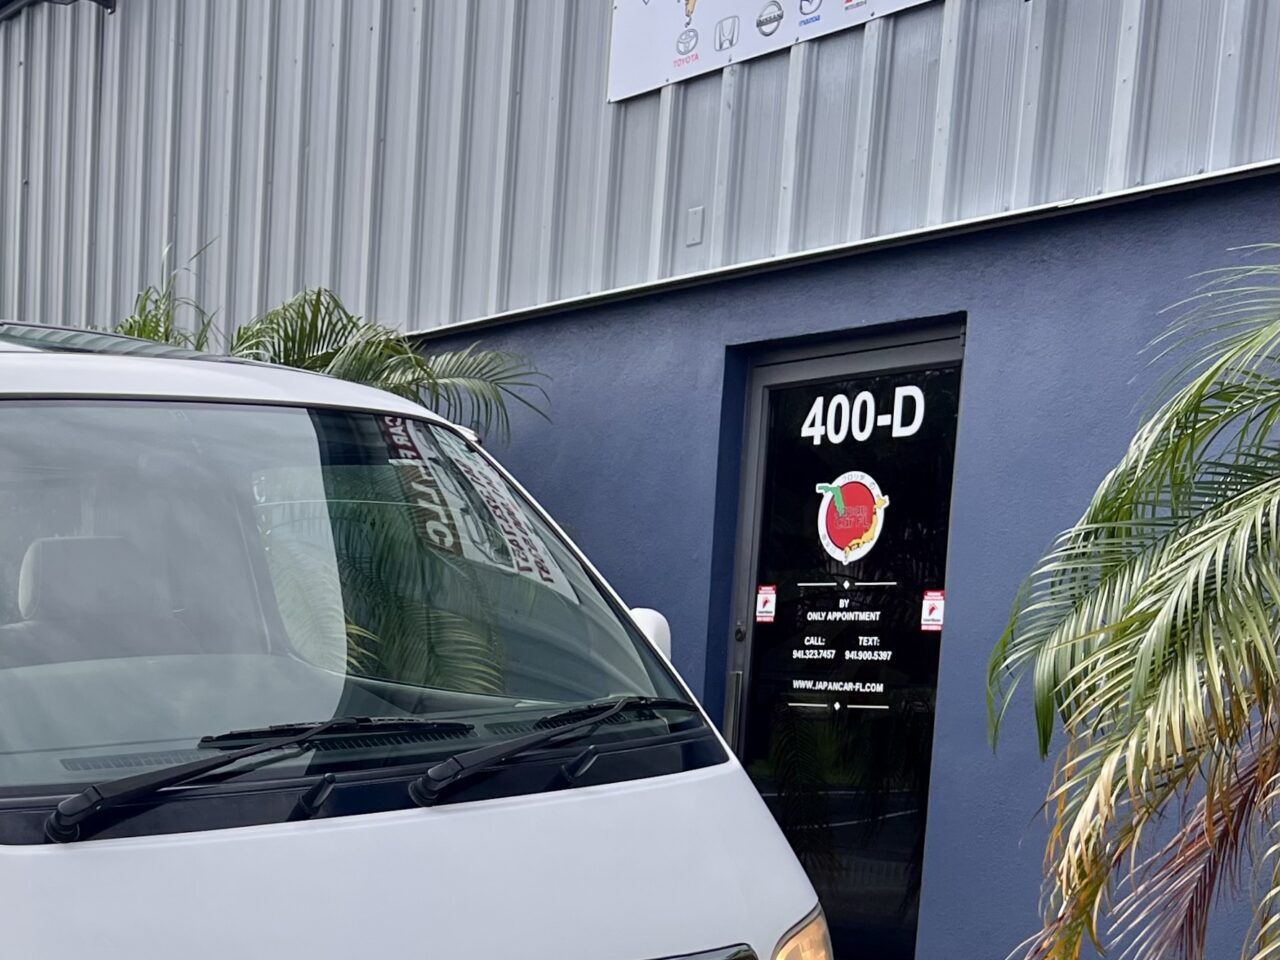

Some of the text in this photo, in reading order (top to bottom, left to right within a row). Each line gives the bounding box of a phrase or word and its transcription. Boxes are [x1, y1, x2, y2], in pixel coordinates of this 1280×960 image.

[673, 53, 700, 67] TOYOTA
[801, 385, 925, 445] 400-D
[838, 598, 851, 609] BY
[806, 610, 881, 621] ONLY APPOINTMENT
[804, 636, 826, 646] CALL:
[858, 635, 881, 646] TEXT:
[792, 649, 836, 659] 941.323.7457
[844, 650, 892, 661] 941.900.5397
[792, 679, 884, 693] WWW.JAPANCAR-FL.COM
